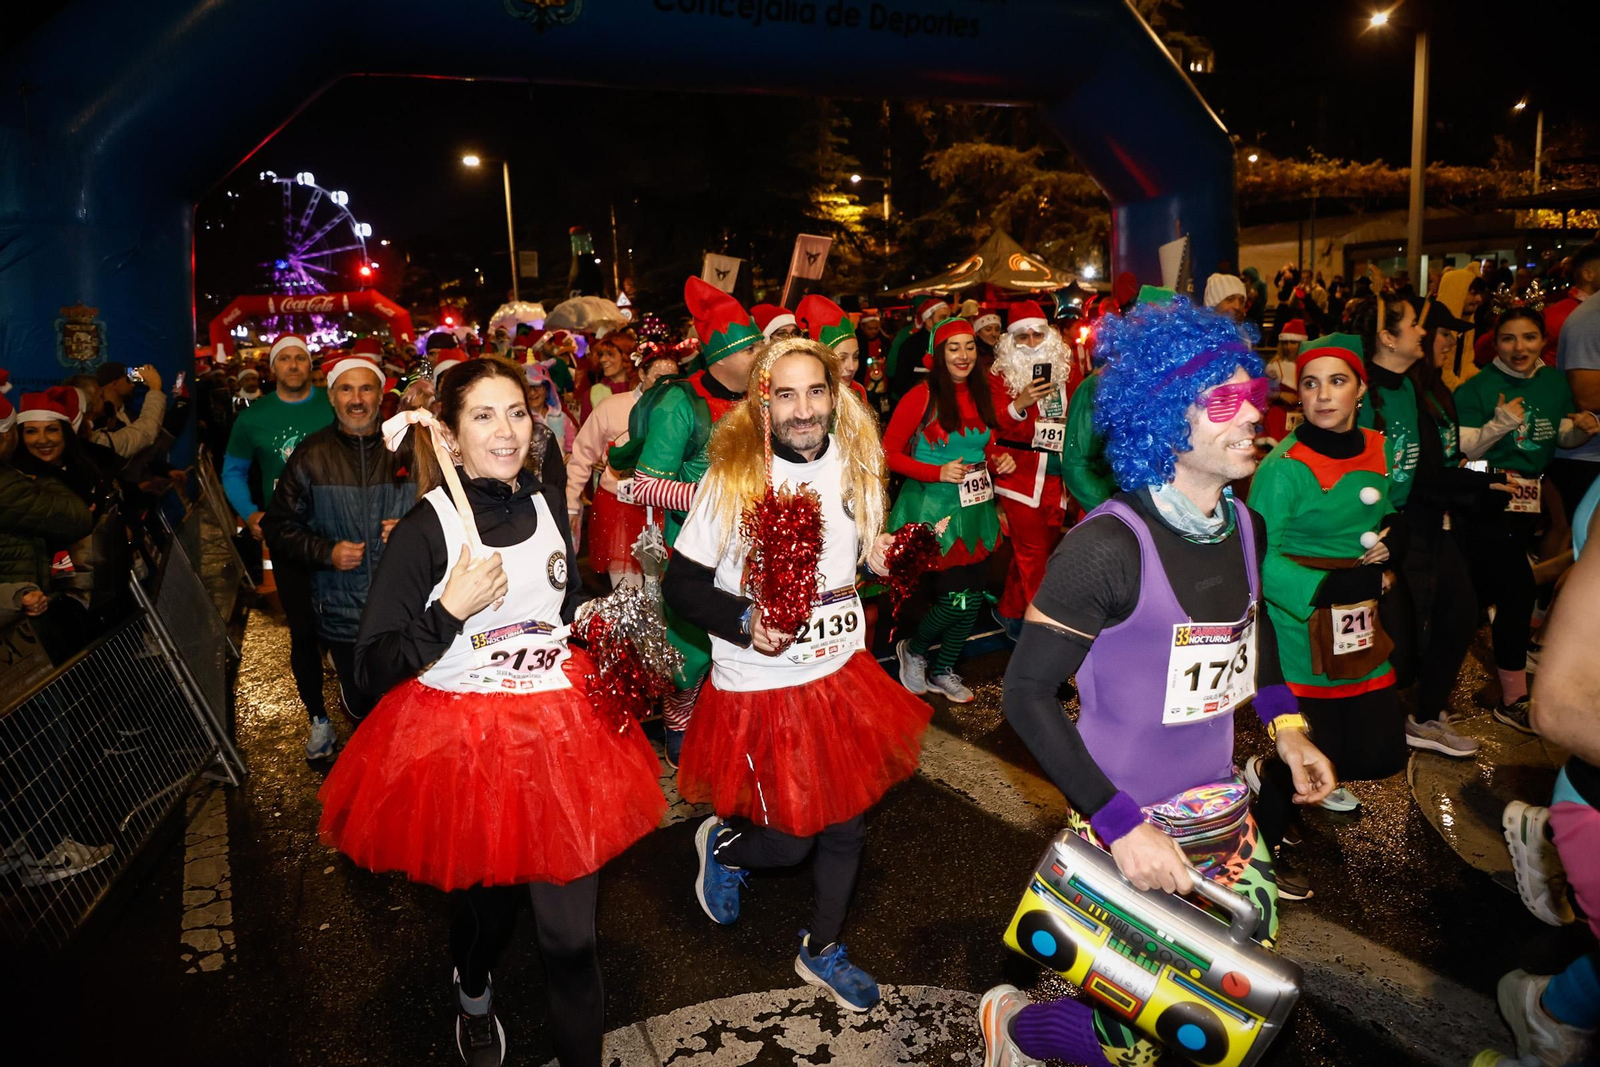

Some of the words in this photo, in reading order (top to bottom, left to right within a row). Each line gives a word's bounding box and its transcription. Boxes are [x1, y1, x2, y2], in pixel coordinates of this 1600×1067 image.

[826, 1, 862, 28] de
[870, 3, 982, 38] Deportes
[1514, 484, 1538, 500] 056
[486, 628, 525, 646] NOCTURNA
[795, 610, 858, 645] 2139
[1175, 626, 1190, 646] 33
[1190, 626, 1233, 637] CARRERA
[1189, 635, 1231, 644] NOCTURNA
